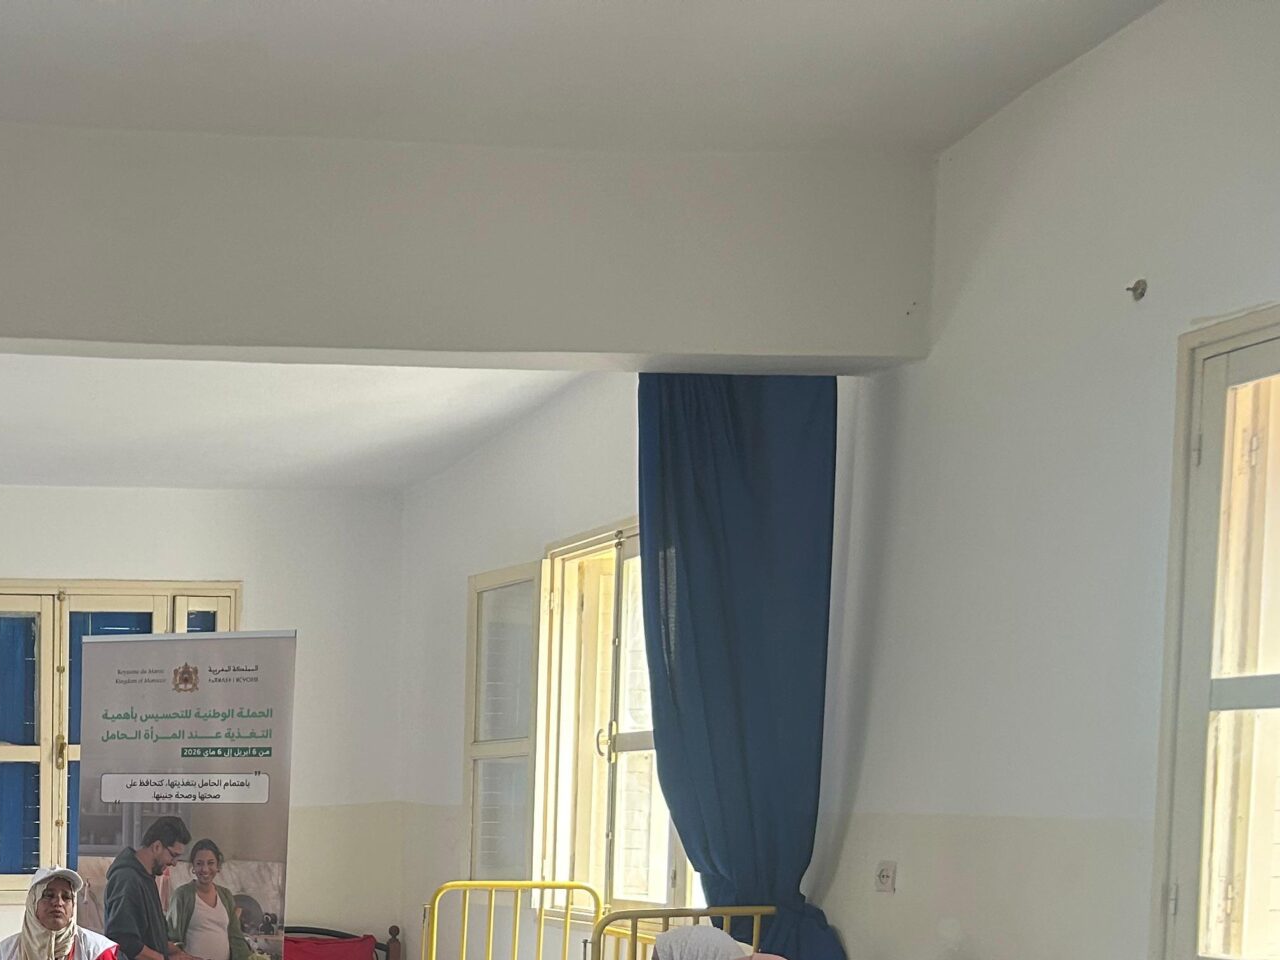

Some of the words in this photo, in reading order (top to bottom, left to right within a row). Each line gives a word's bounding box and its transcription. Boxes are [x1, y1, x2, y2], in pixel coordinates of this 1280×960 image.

[102, 706, 138, 721] بأهمية
[140, 709, 192, 722] للتحسيس
[194, 708, 235, 722] الوطنية
[237, 708, 273, 720] الحملة
[202, 749, 217, 758] ماي
[224, 748, 233, 758] إلى
[234, 746, 252, 757] أبريل
[258, 748, 271, 757] من
[126, 779, 138, 789] على
[139, 778, 164, 788] كتحافظ
[197, 778, 222, 789] الحامل
[223, 778, 251, 788] باهتمام
[175, 791, 197, 801] وصحة
[197, 792, 220, 800] صحتها
